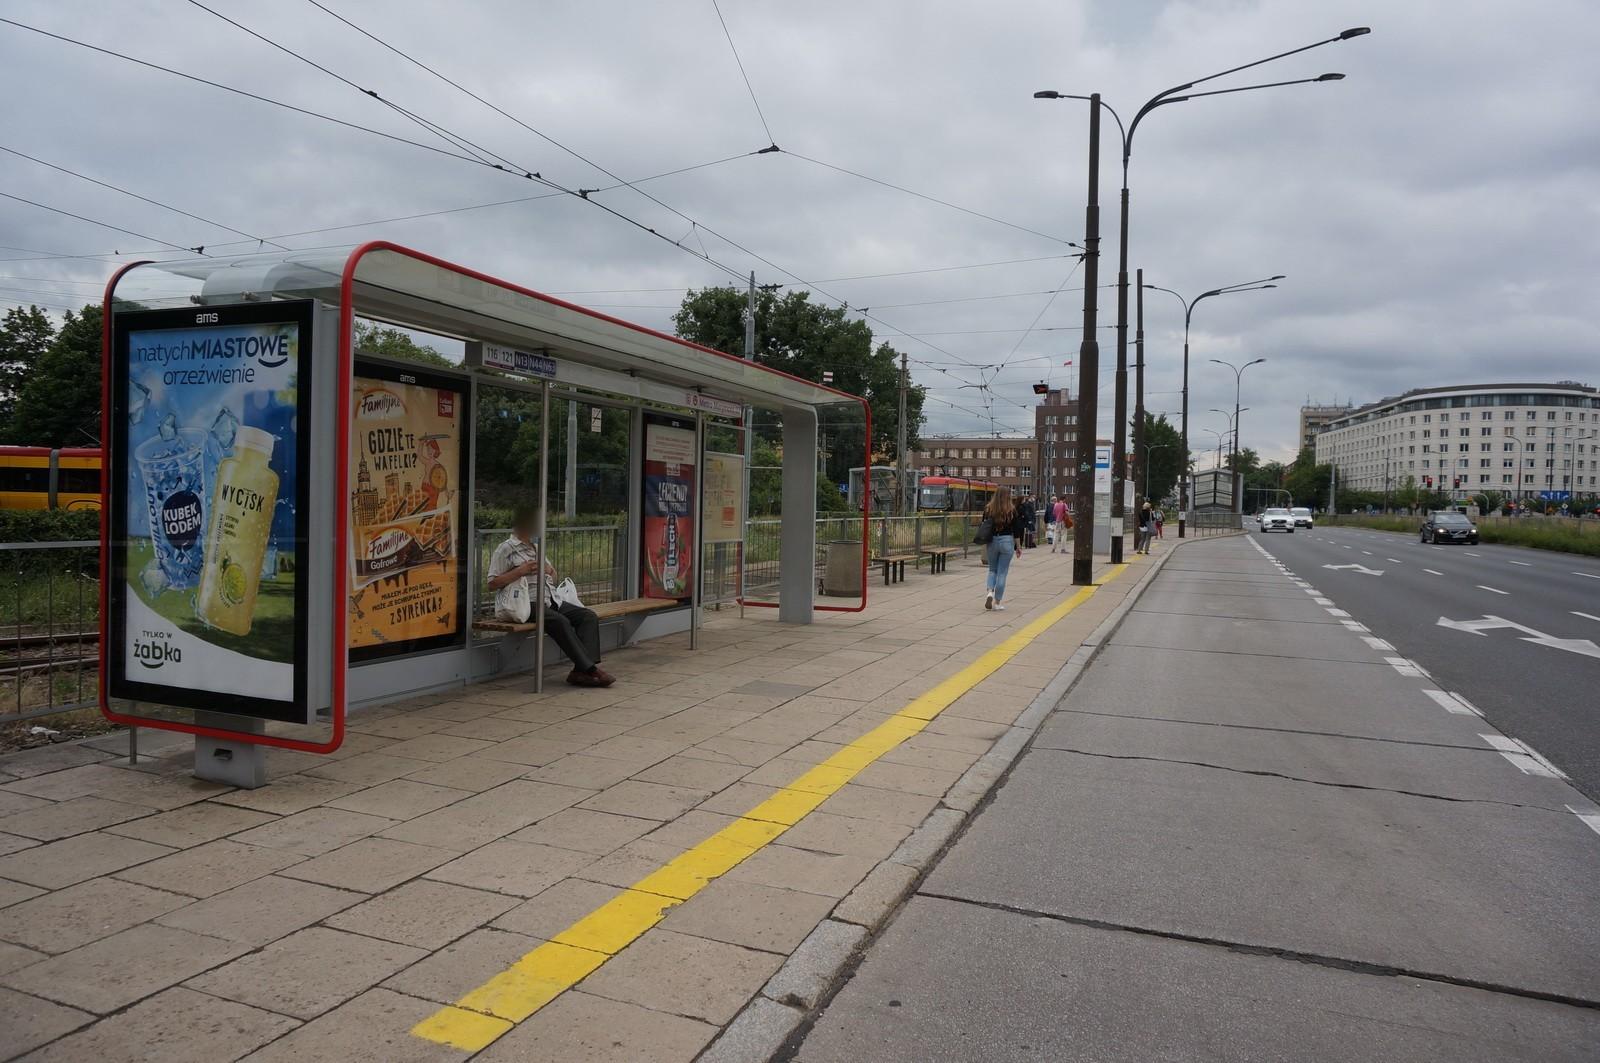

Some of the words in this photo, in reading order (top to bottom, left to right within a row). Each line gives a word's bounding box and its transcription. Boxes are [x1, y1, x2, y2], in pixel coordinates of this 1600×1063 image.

[196, 313, 219, 324] ams
[137, 335, 289, 367] natychMIASTOWE
[487, 347, 498, 359] 116
[502, 351, 513, 363] 121
[515, 353, 528, 367] N13
[163, 363, 255, 386] orzeźwienie
[400, 374, 416, 384] ams
[368, 427, 404, 455] GDZIE
[405, 434, 415, 449] TE
[374, 452, 417, 471] WAFELKI?
[146, 483, 164, 561] CHILLOUT
[163, 502, 197, 522] KUBEK
[165, 513, 202, 535] LODEM
[369, 530, 408, 558] Familijne
[142, 630, 165, 639] TYLKO
[133, 638, 182, 663] żabka
